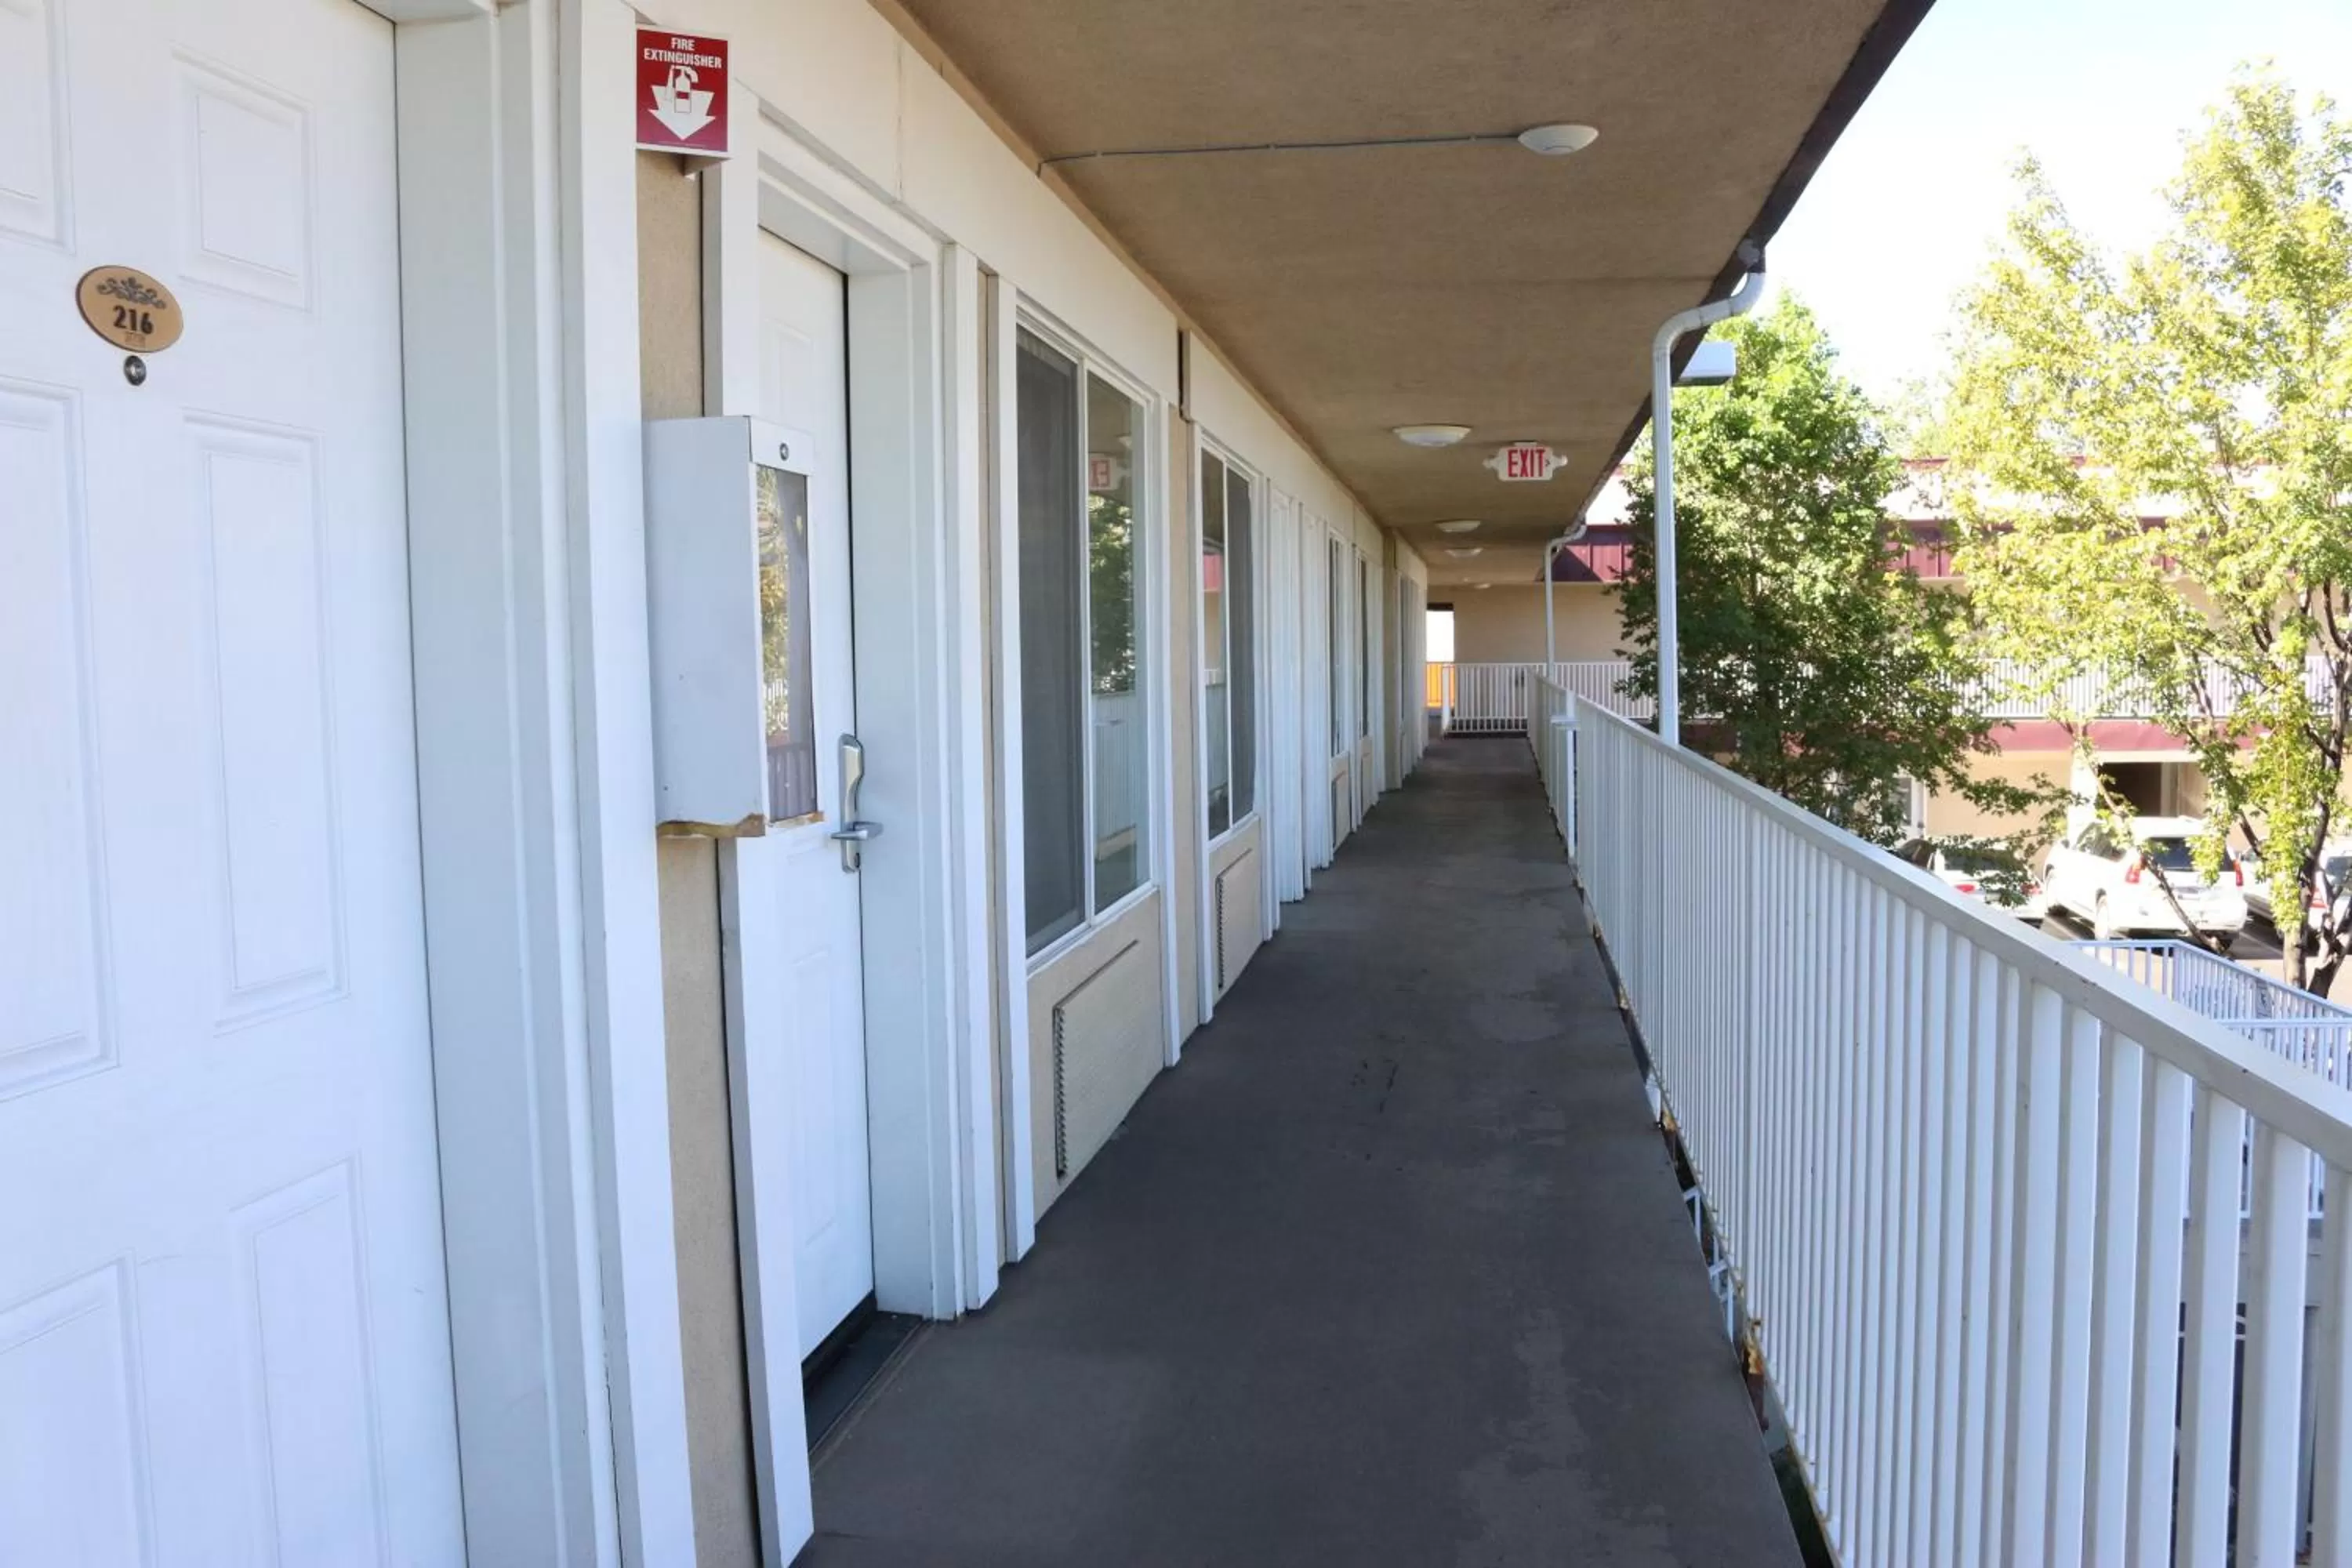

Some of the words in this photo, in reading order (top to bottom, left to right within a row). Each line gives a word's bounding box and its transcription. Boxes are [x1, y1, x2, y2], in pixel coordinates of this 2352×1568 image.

[670, 37, 695, 51] FIRE
[644, 48, 722, 69] EXTINGUISHER
[113, 304, 154, 335] 216
[1508, 449, 1545, 477] EXIT
